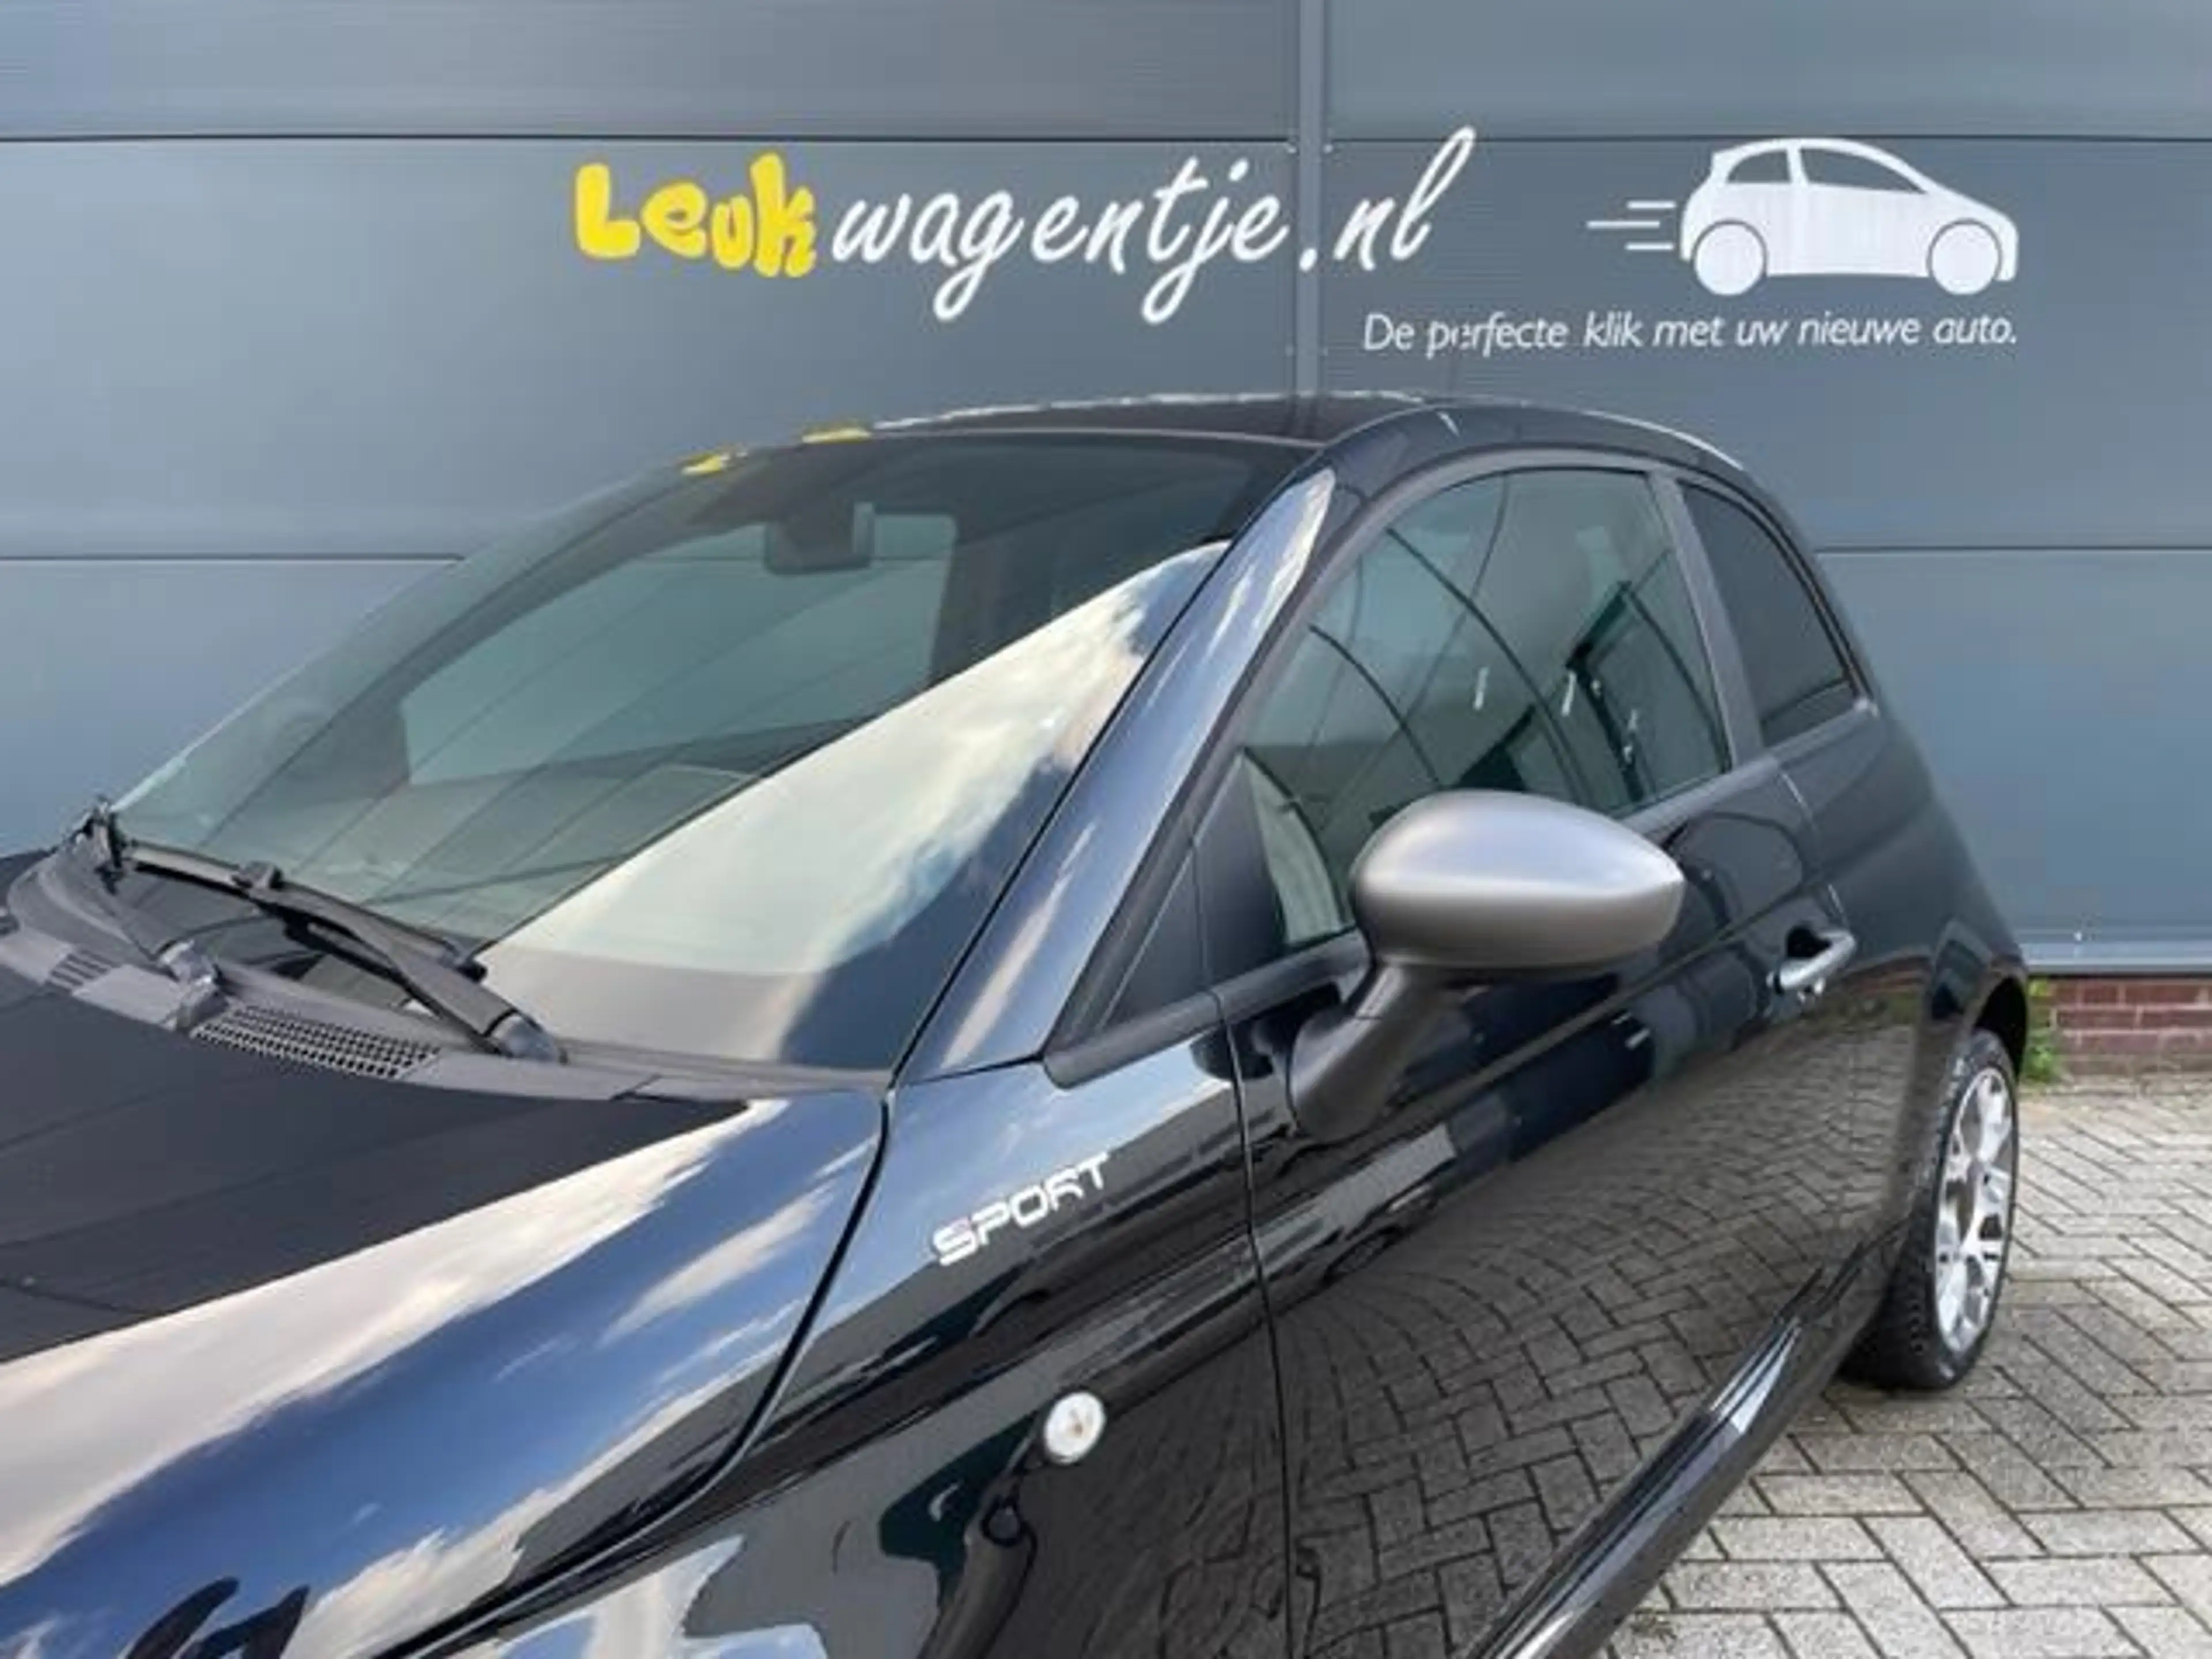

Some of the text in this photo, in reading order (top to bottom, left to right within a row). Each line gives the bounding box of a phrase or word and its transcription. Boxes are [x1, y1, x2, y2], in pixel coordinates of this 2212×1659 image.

[1363, 310, 2017, 360] De perfecte klik met uw nieuwe auto.
[933, 1152, 1108, 1266] SPORT
